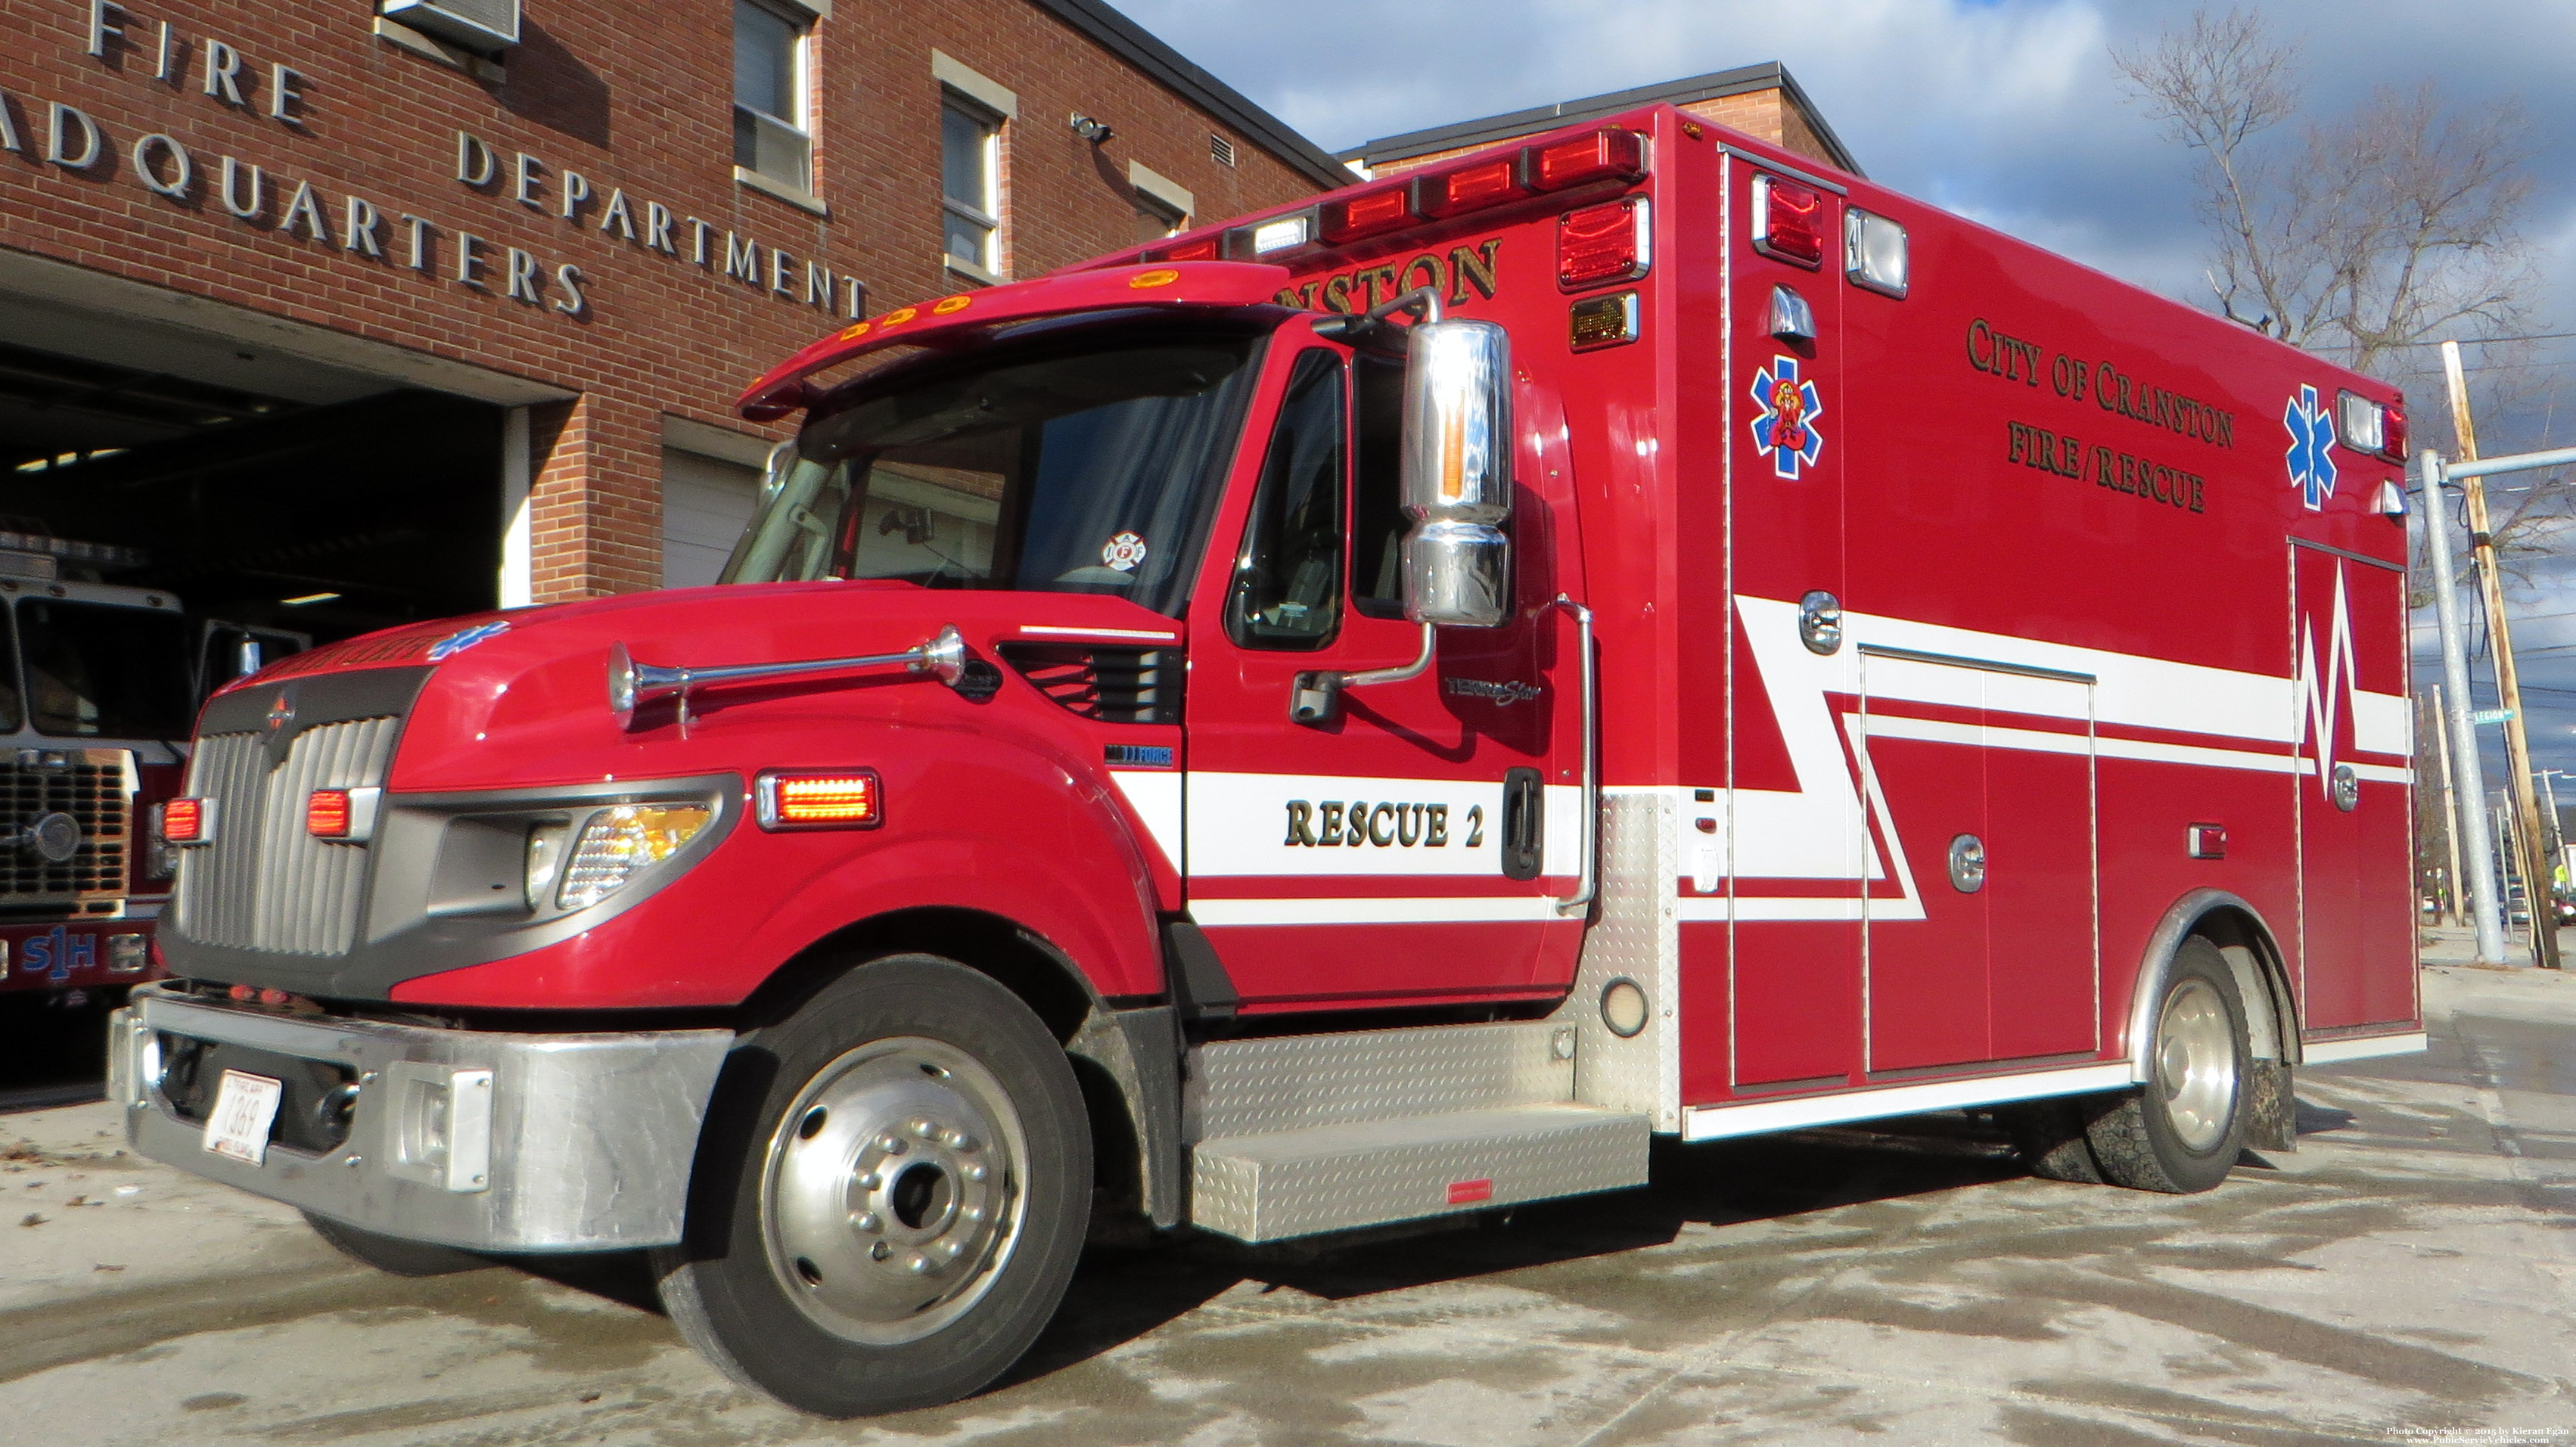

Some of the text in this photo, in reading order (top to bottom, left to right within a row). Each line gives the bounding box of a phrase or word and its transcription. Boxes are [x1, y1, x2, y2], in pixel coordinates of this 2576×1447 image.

[88, 0, 303, 125] FIRE
[457, 130, 865, 319] DEPARTMENT
[1967, 318, 2234, 449] CITY OF CRANSTON
[2009, 420, 2205, 513] FIRE/RESCUE
[1284, 799, 1484, 847] RESCUE 2
